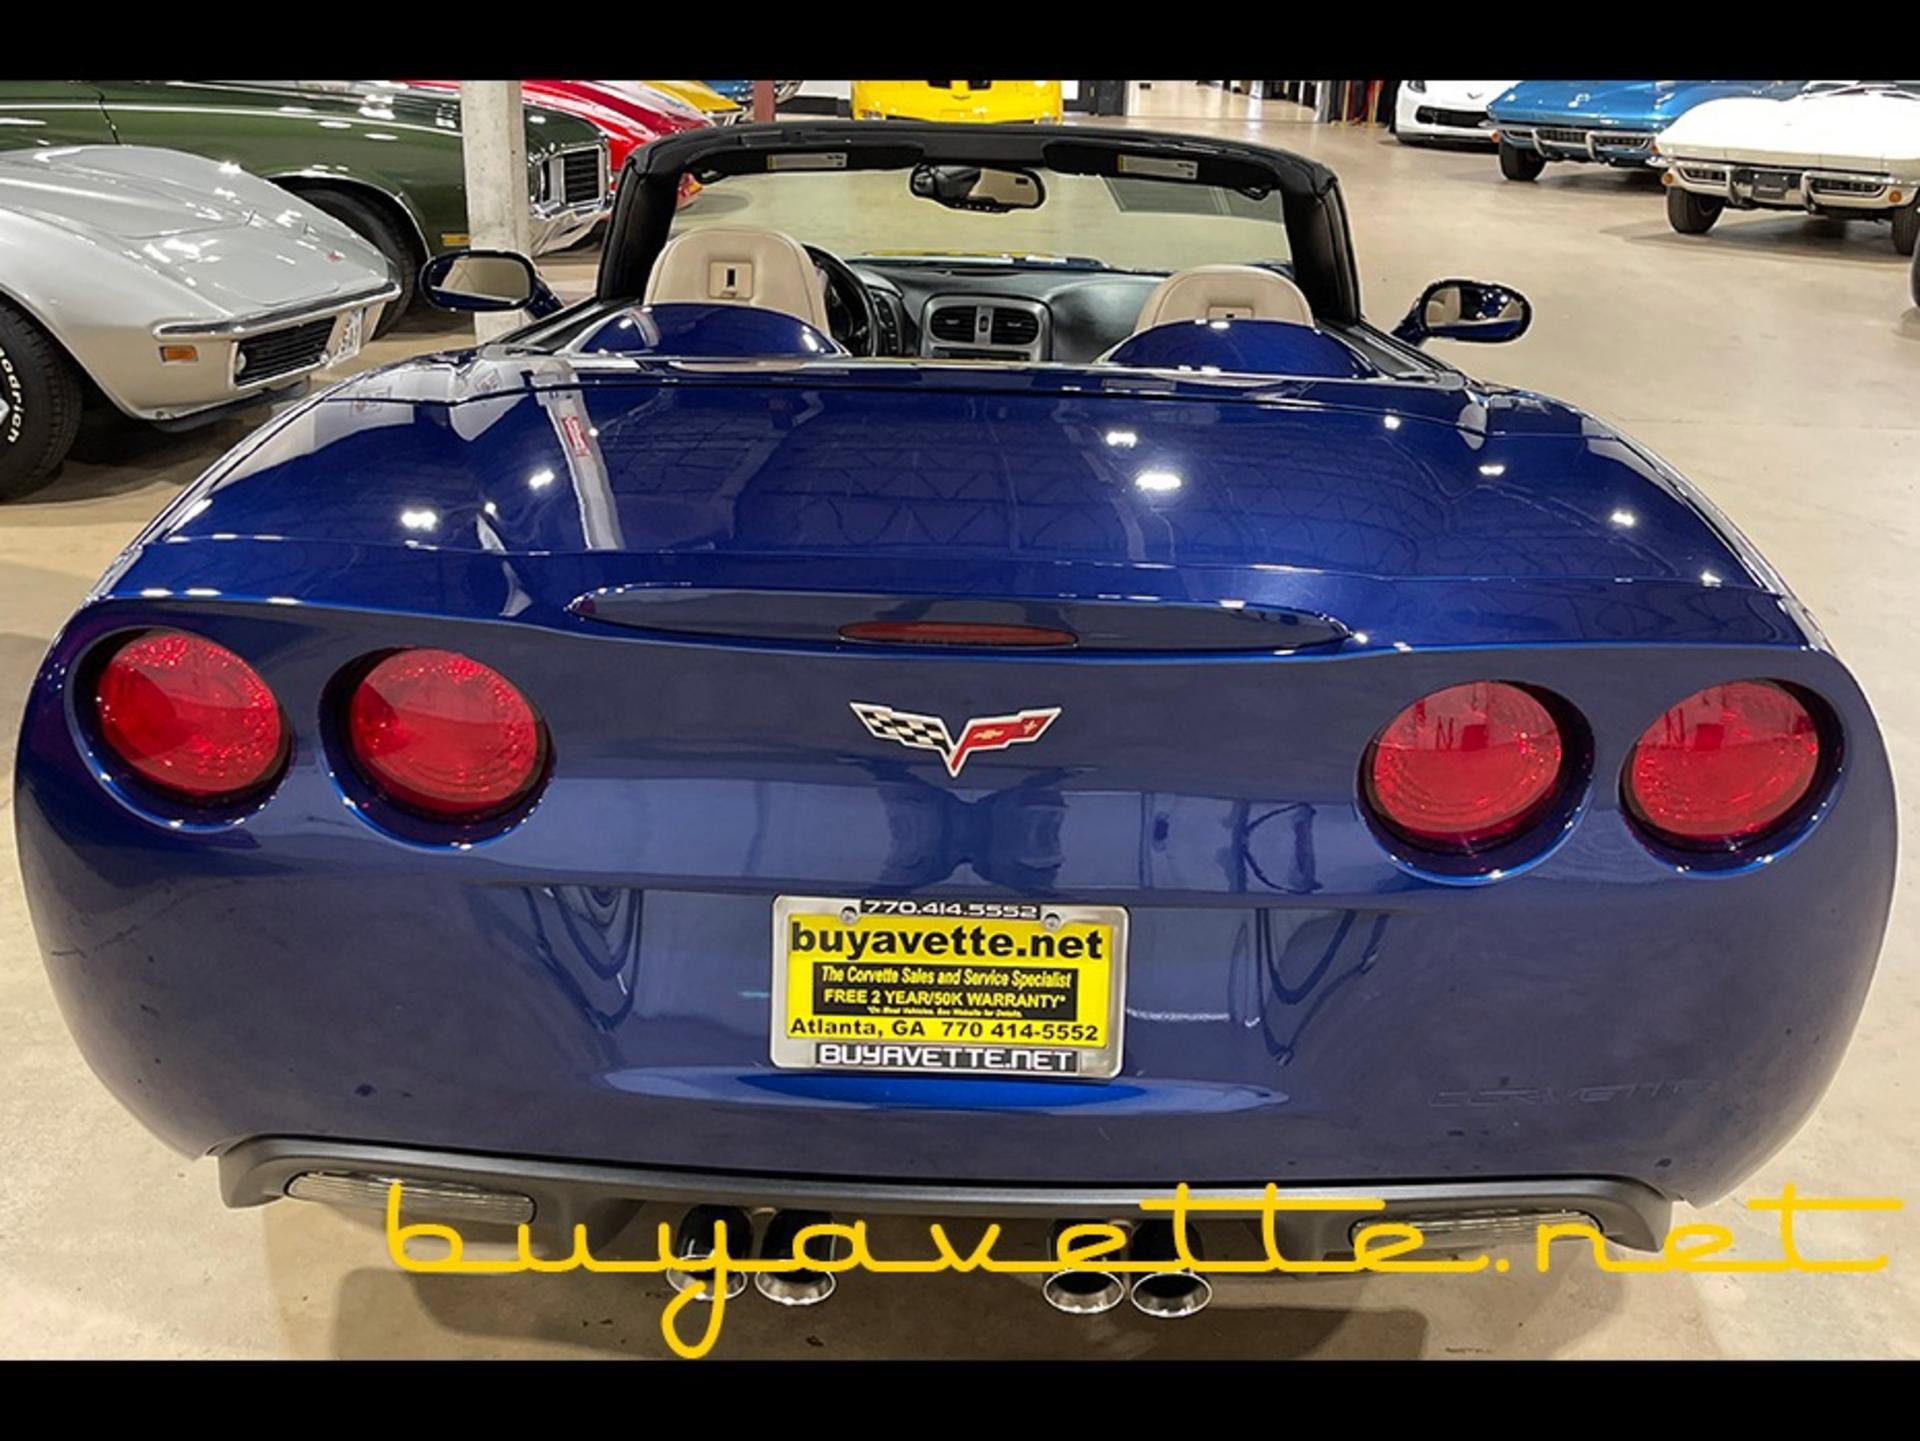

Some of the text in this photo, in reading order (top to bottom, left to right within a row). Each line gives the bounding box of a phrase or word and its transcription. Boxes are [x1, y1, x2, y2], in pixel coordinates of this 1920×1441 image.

[863, 900, 1038, 918] 770.414.5552
[791, 921, 1103, 960] buyavette.net
[822, 965, 1072, 990] The Corvette Sales and Service Specialist
[824, 988, 867, 1003] FREE
[871, 990, 881, 1004] 2
[884, 990, 963, 1006] YEAR/50K
[790, 1018, 1099, 1041] Atlanta, GA 770 414-5552
